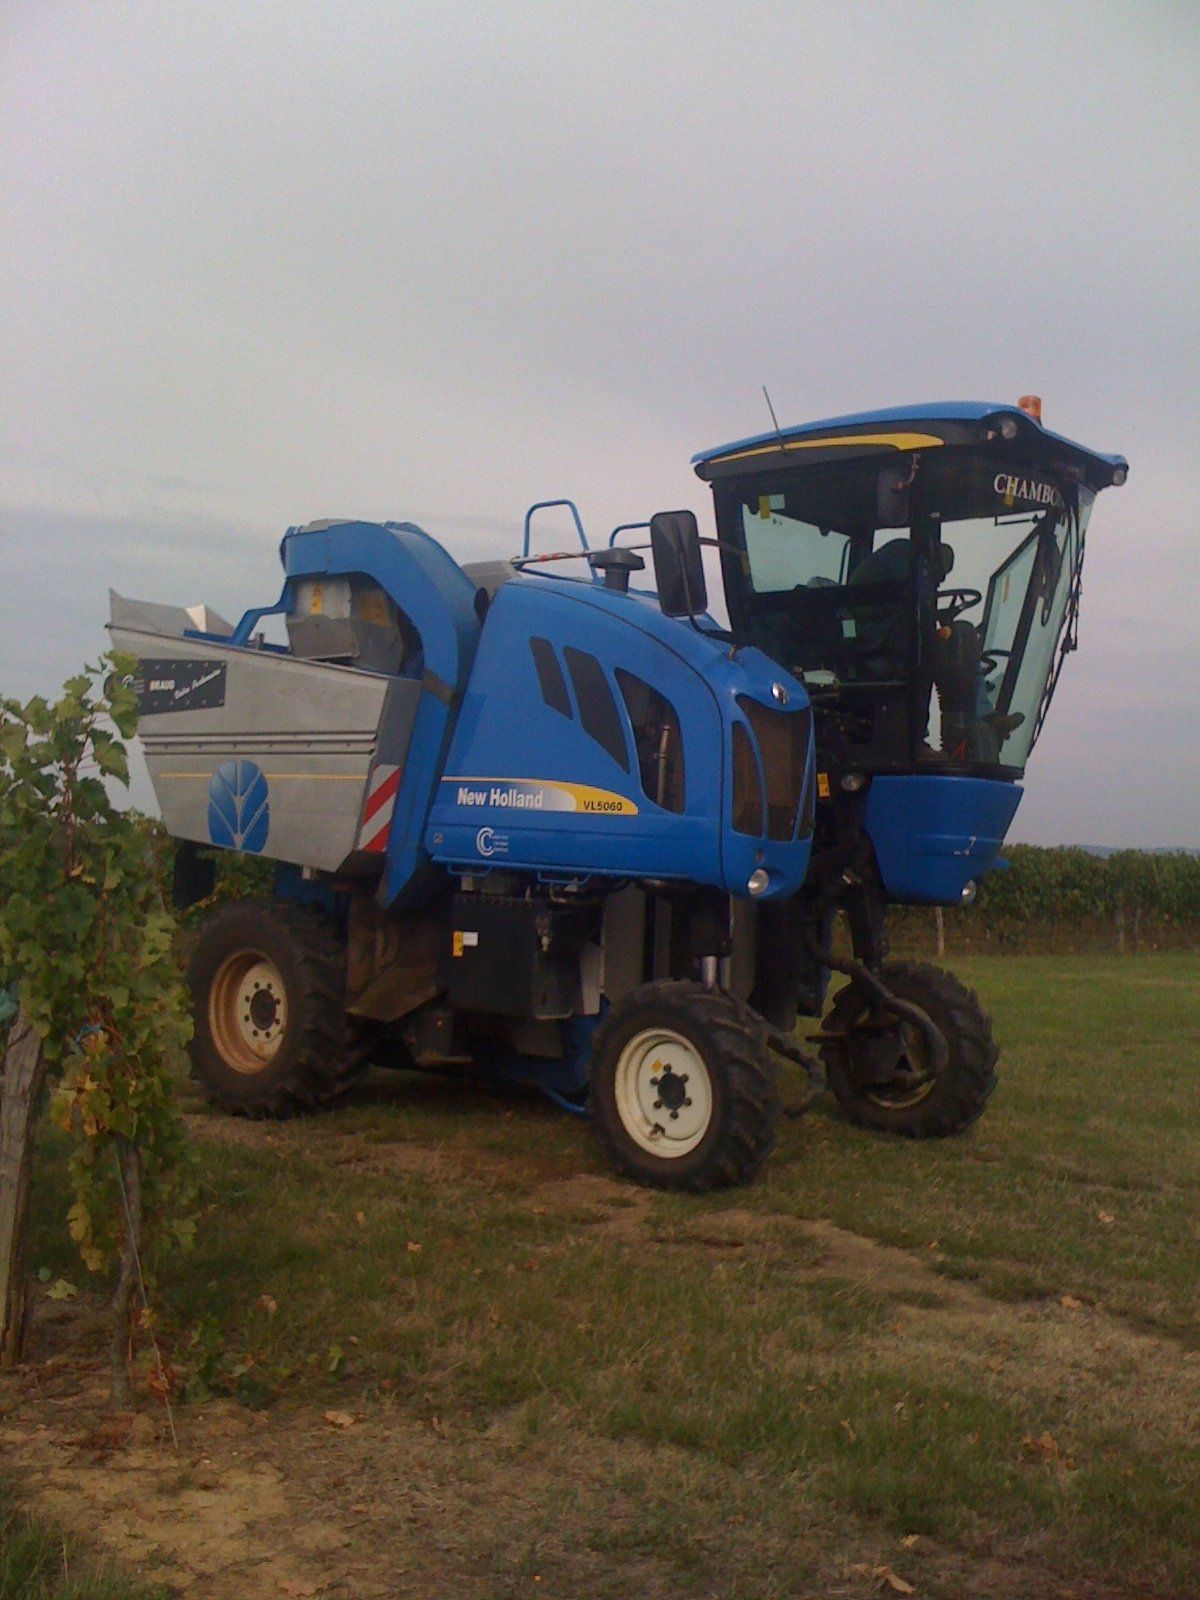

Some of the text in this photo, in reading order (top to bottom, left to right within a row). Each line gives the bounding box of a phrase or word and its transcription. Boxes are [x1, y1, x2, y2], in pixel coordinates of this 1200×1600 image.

[993, 473, 1065, 508] CHAMBO
[457, 787, 544, 809] New Holland
[583, 800, 623, 812] VL5060
